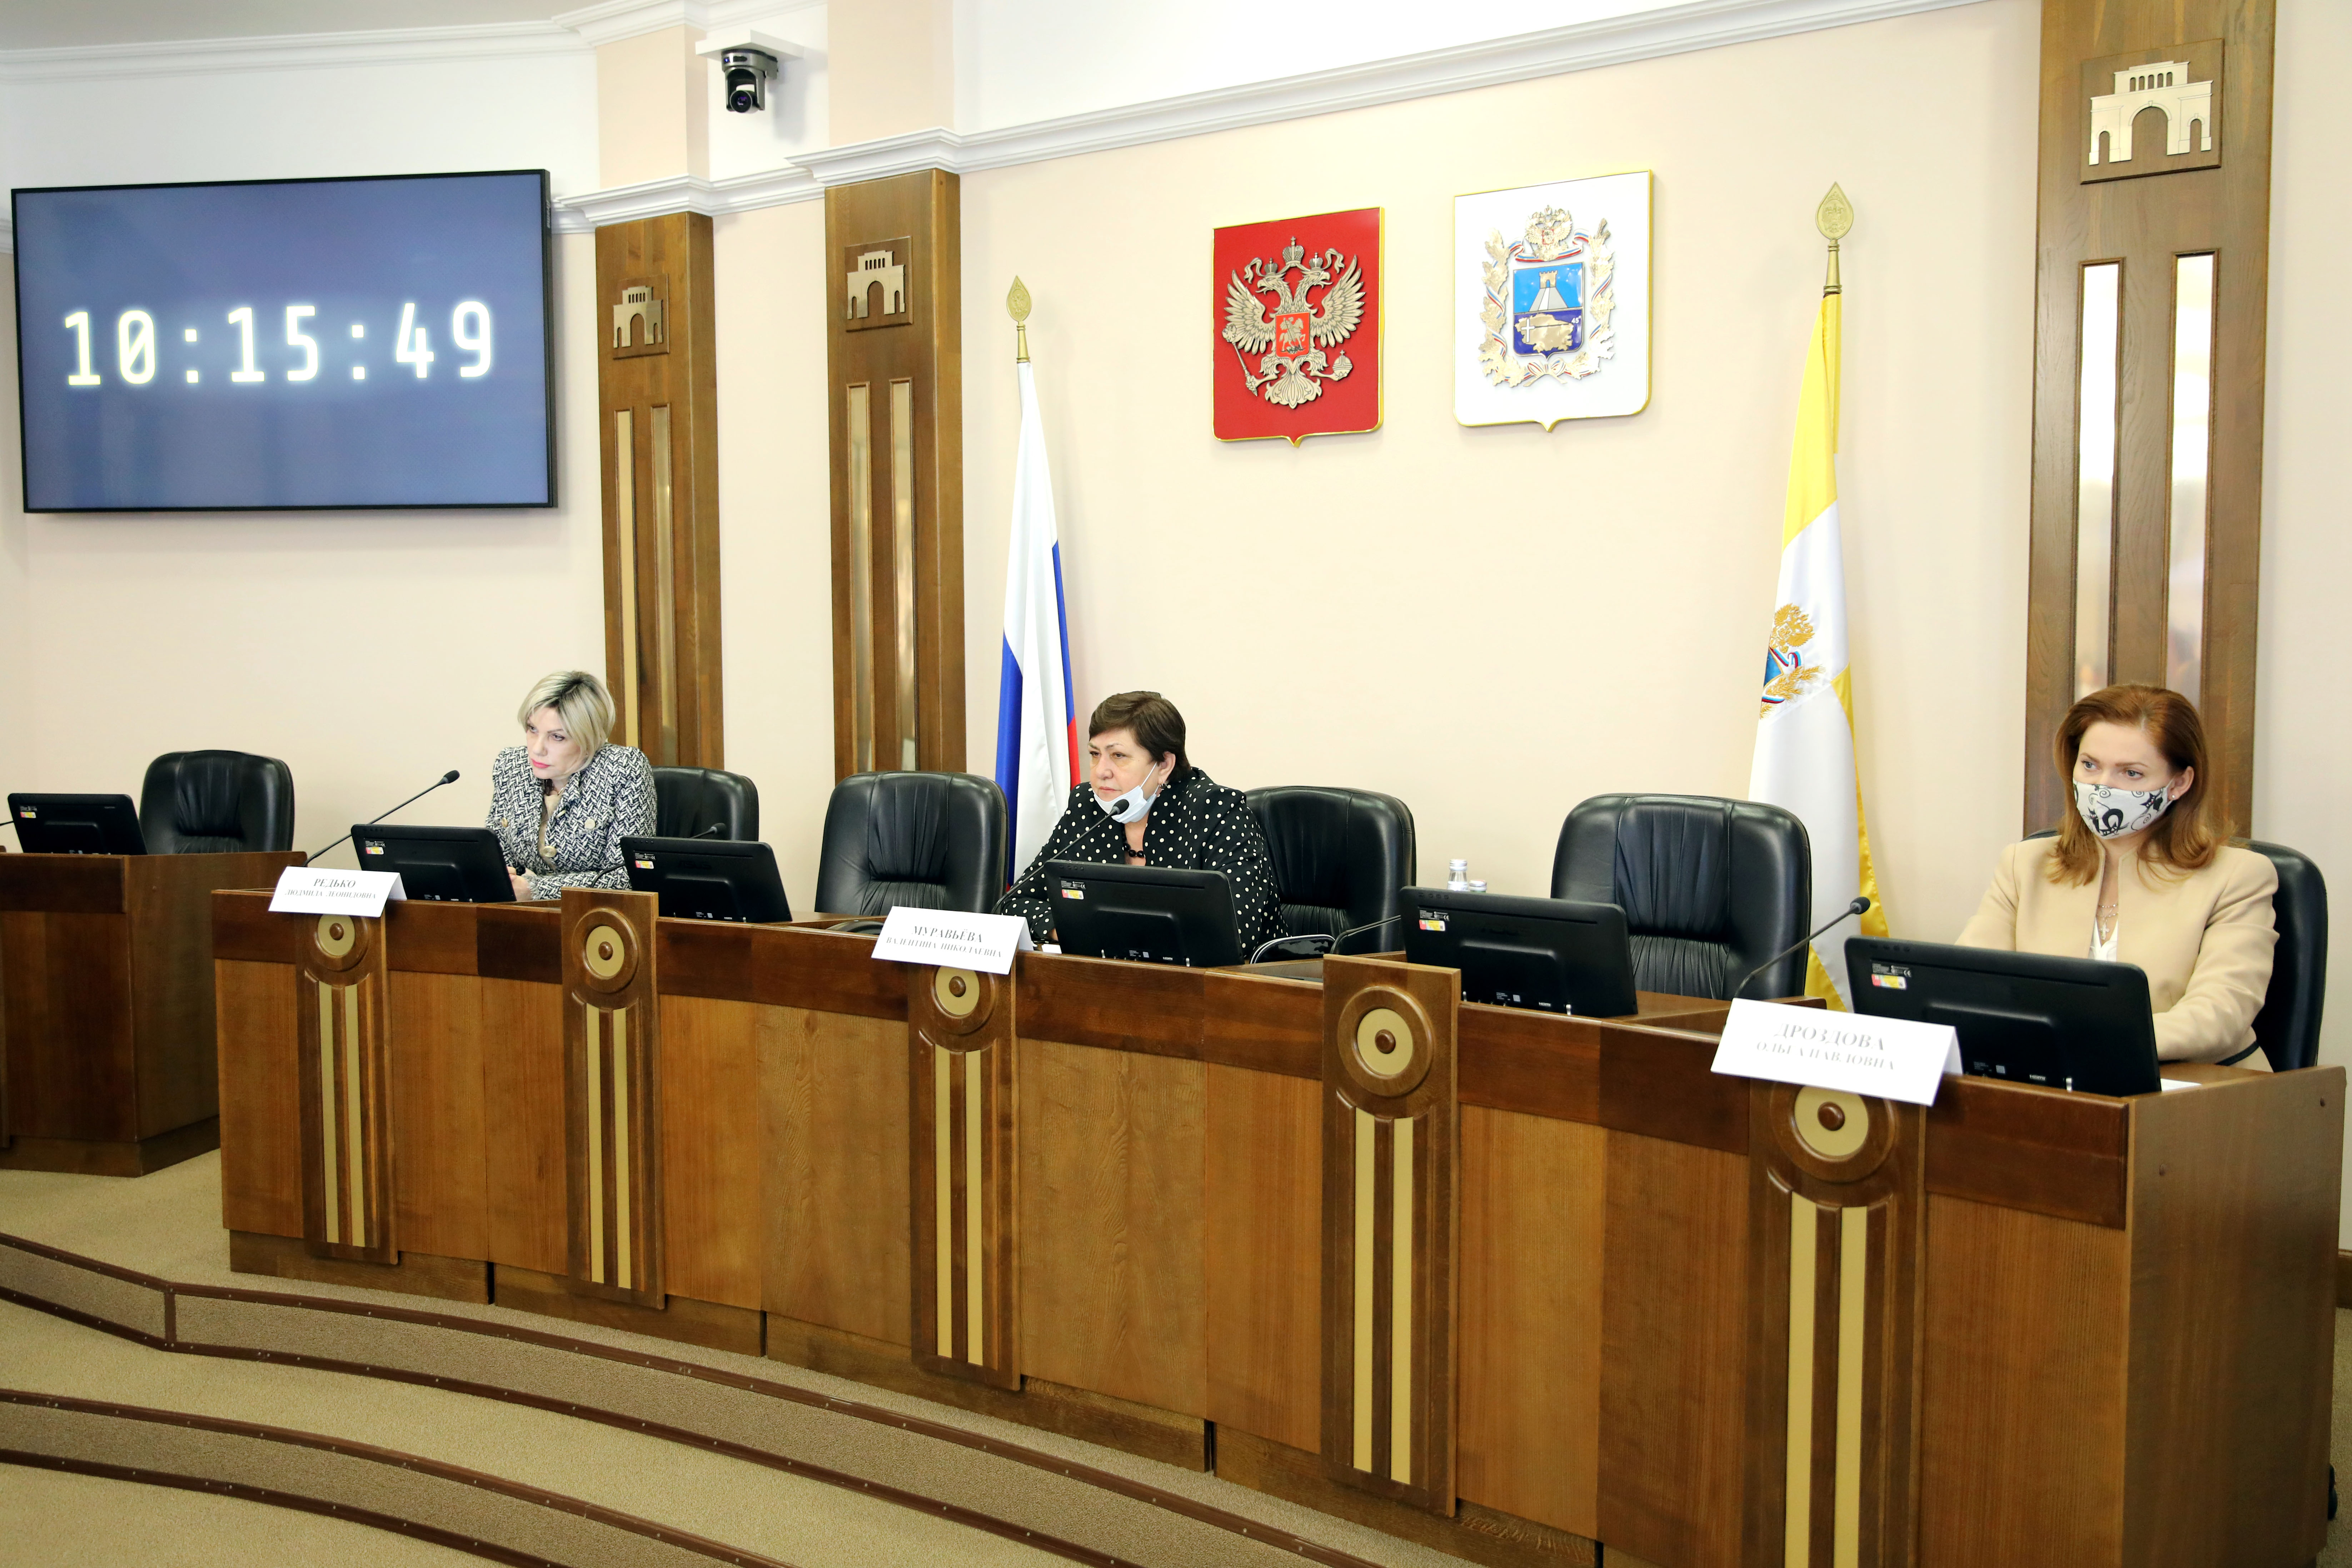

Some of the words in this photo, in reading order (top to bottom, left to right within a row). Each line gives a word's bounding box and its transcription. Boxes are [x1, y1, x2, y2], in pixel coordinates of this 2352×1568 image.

[65, 301, 492, 386] 10:15:49
[313, 879, 356, 888] РЕДЬКО
[326, 891, 376, 899] ЛЕОНИДОВНА
[912, 925, 982, 943] МУРАВЬЁВА
[886, 937, 937, 949] ВАЛЕНТИНА
[941, 943, 1001, 958] НИКОЛАЕВНА
[1773, 1023, 1884, 1050] ДРОЗДОВА
[1756, 1041, 1804, 1057] ОЛЬГА
[1809, 1048, 1894, 1070] ПАВЛОВНА
